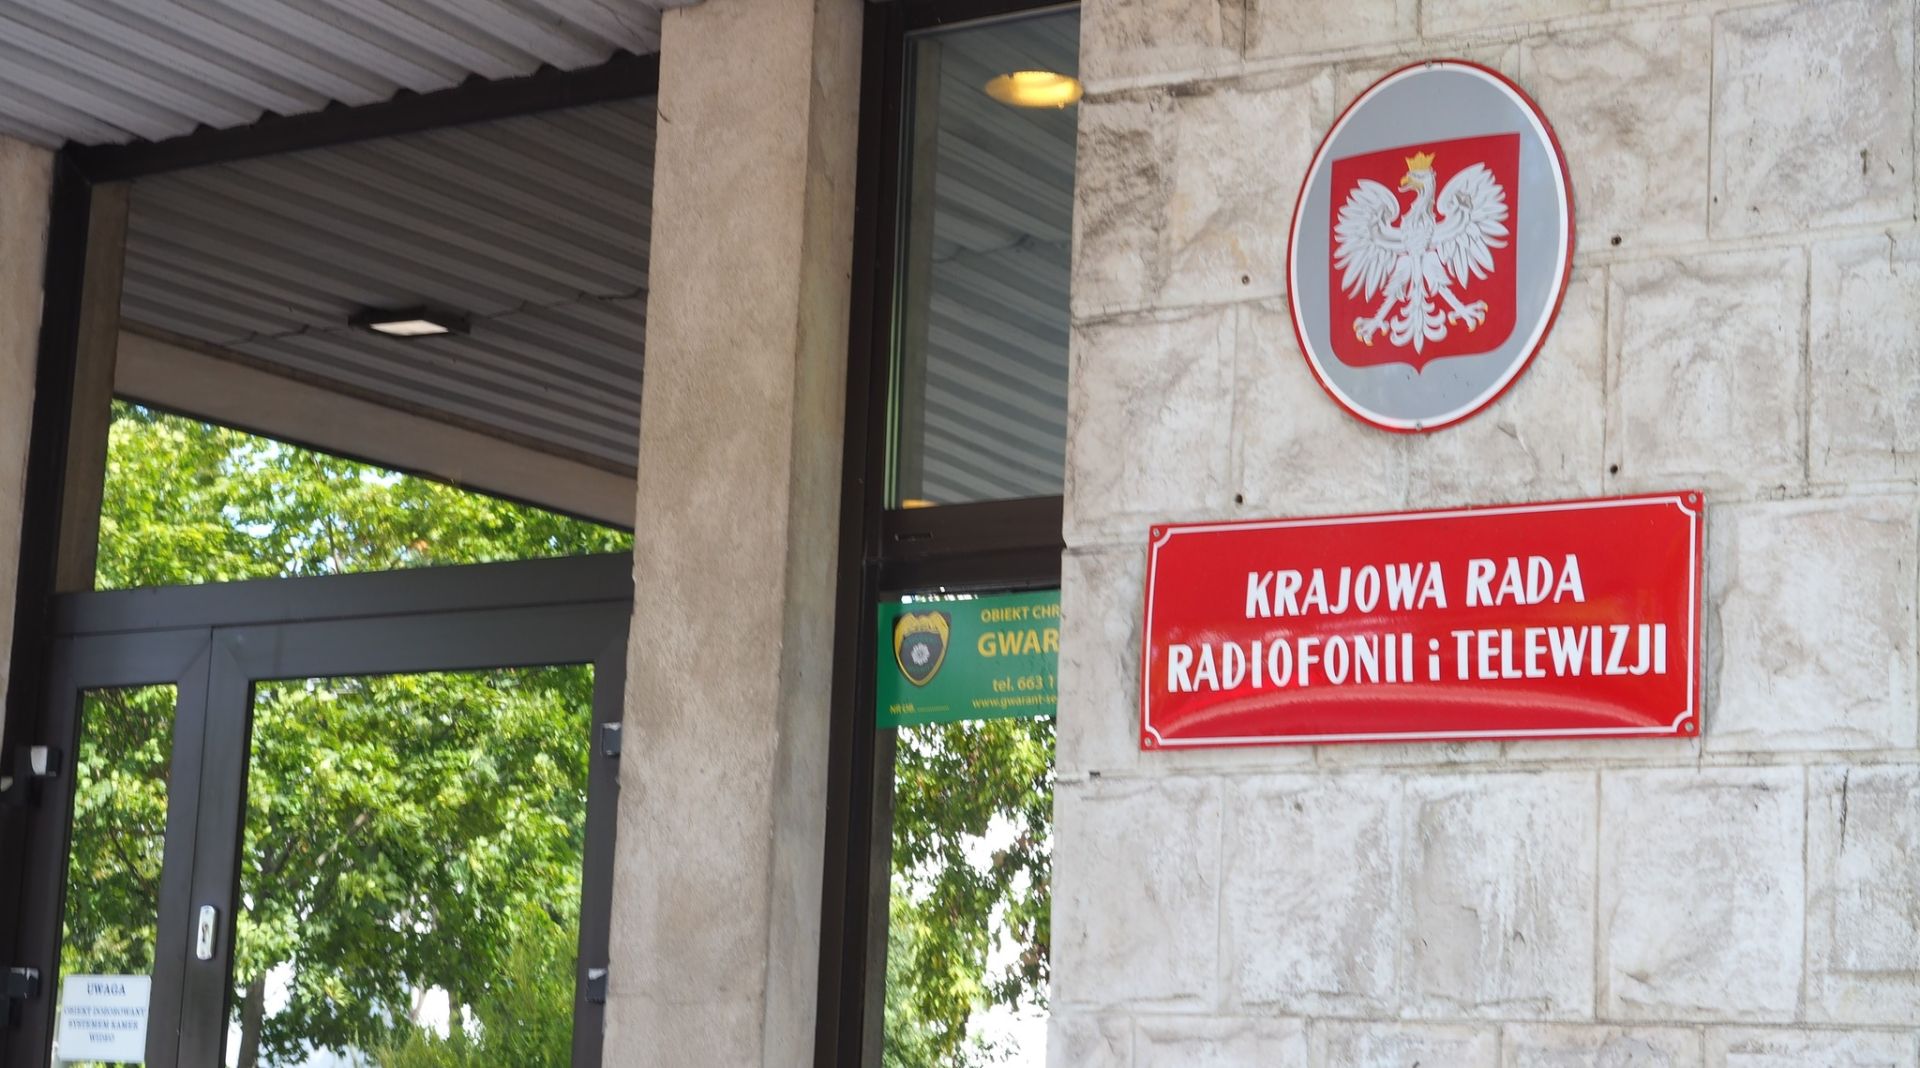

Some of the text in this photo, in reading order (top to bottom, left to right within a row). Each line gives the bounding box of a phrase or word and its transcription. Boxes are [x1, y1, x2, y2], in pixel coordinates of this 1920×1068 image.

[1245, 553, 1586, 618] KRAJOWA RADA
[980, 603, 1060, 624] OBIEKT CHR
[977, 628, 1060, 657] GWAR
[1167, 623, 1667, 693] RADIOFONII i TELEWIZJI
[992, 676, 1014, 693] tel.
[1017, 674, 1043, 691] 663
[87, 982, 126, 995] UWAGA
